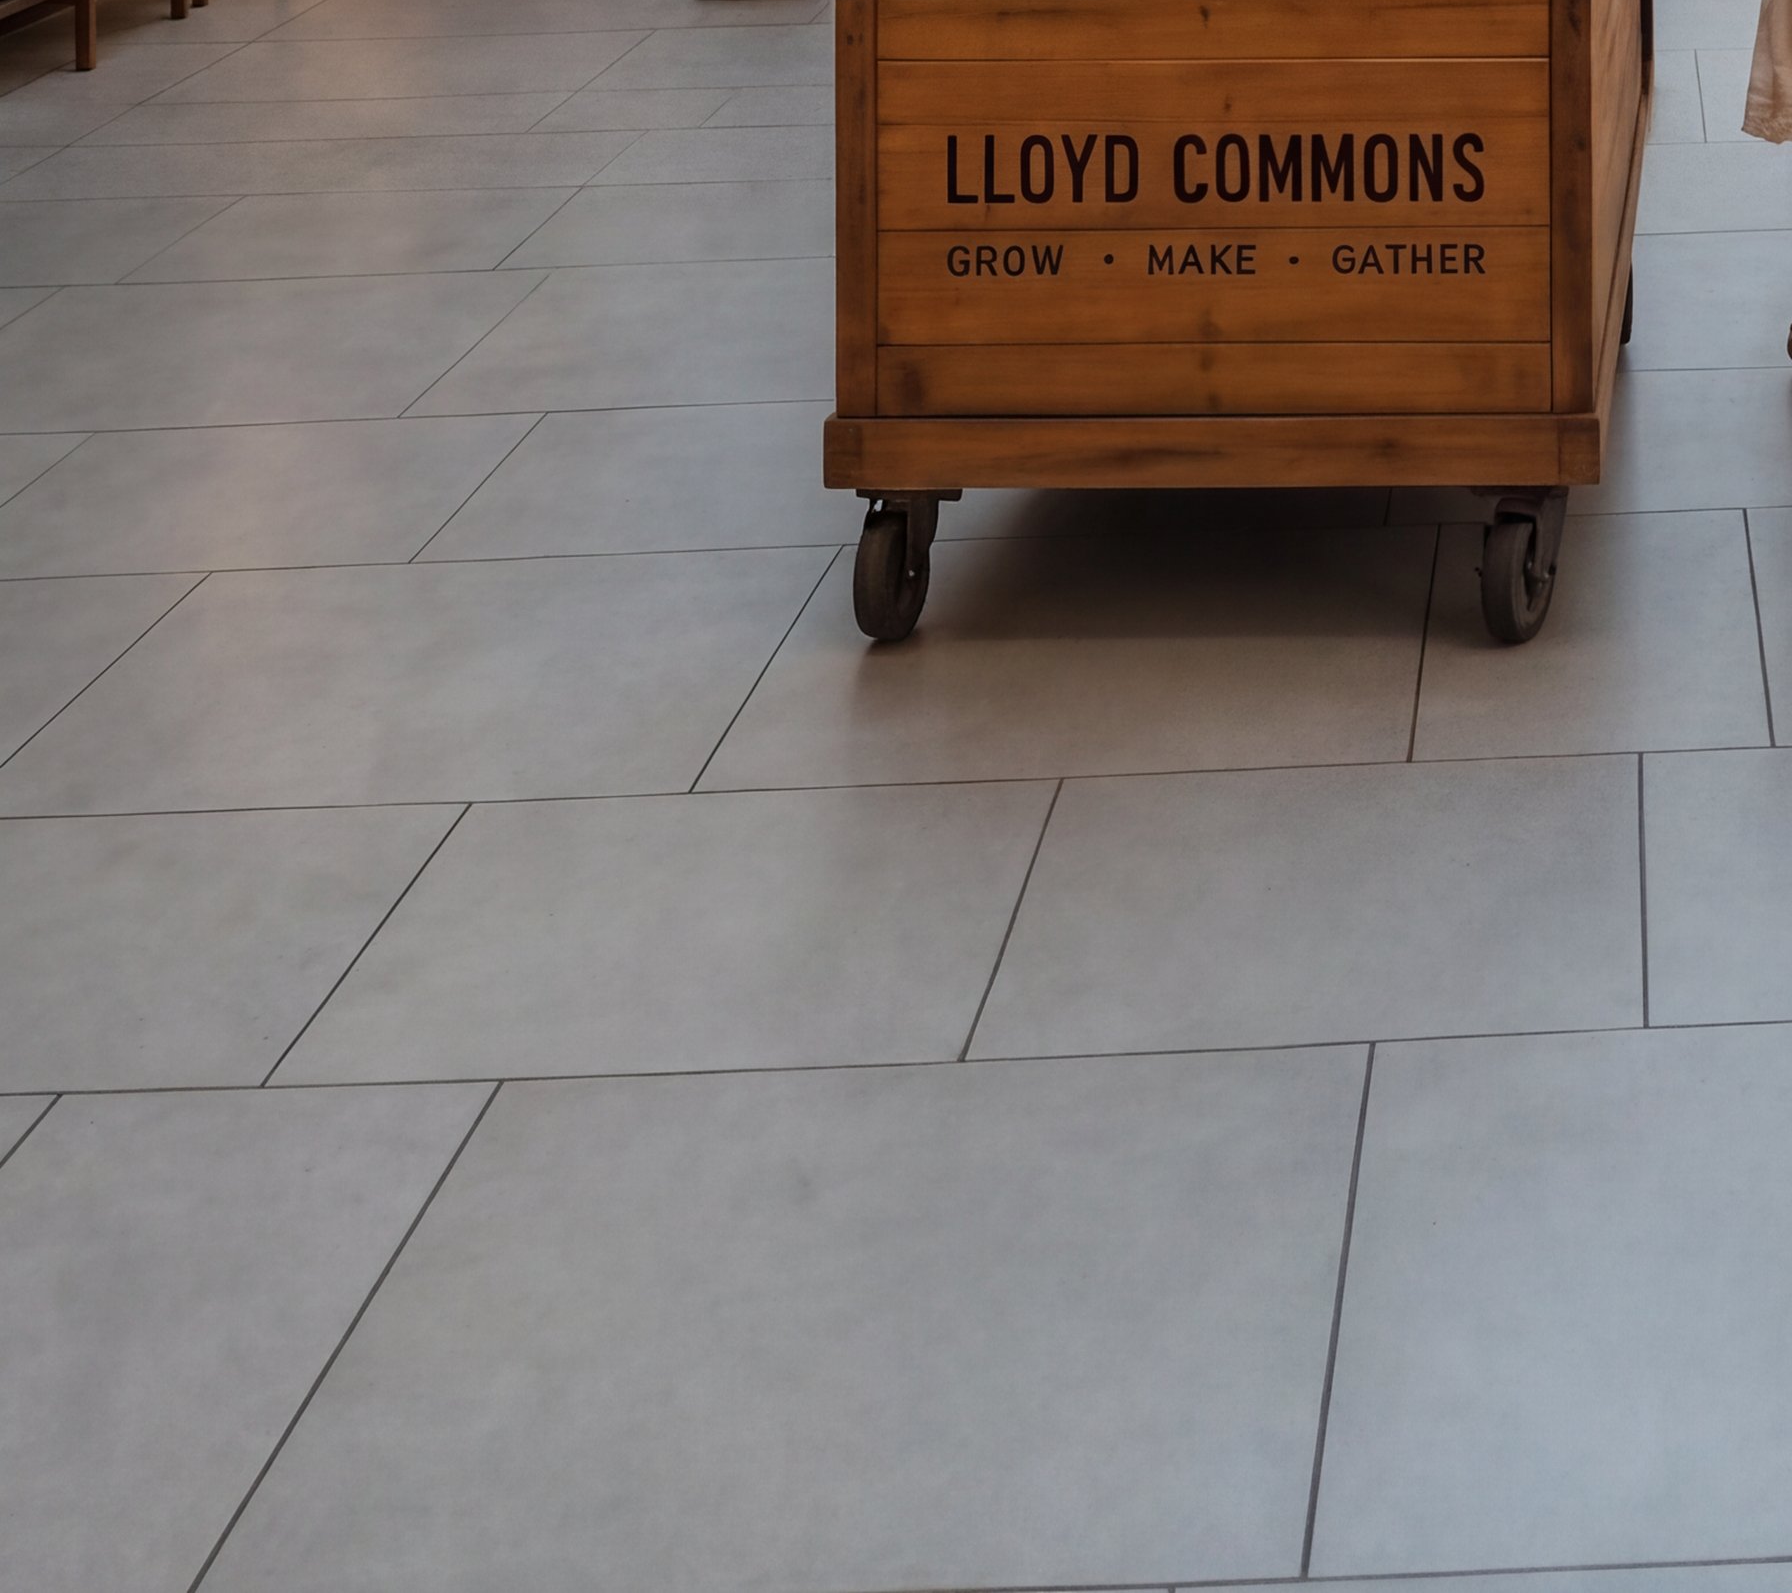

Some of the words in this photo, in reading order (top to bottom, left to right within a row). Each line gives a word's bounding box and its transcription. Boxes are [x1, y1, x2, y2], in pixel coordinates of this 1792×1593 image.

[946, 134, 1140, 205] LLOYD
[1172, 132, 1486, 204] COMMONS
[946, 245, 1065, 277] GROW
[1147, 244, 1258, 276] MAKE
[1331, 243, 1487, 276] GATHER
